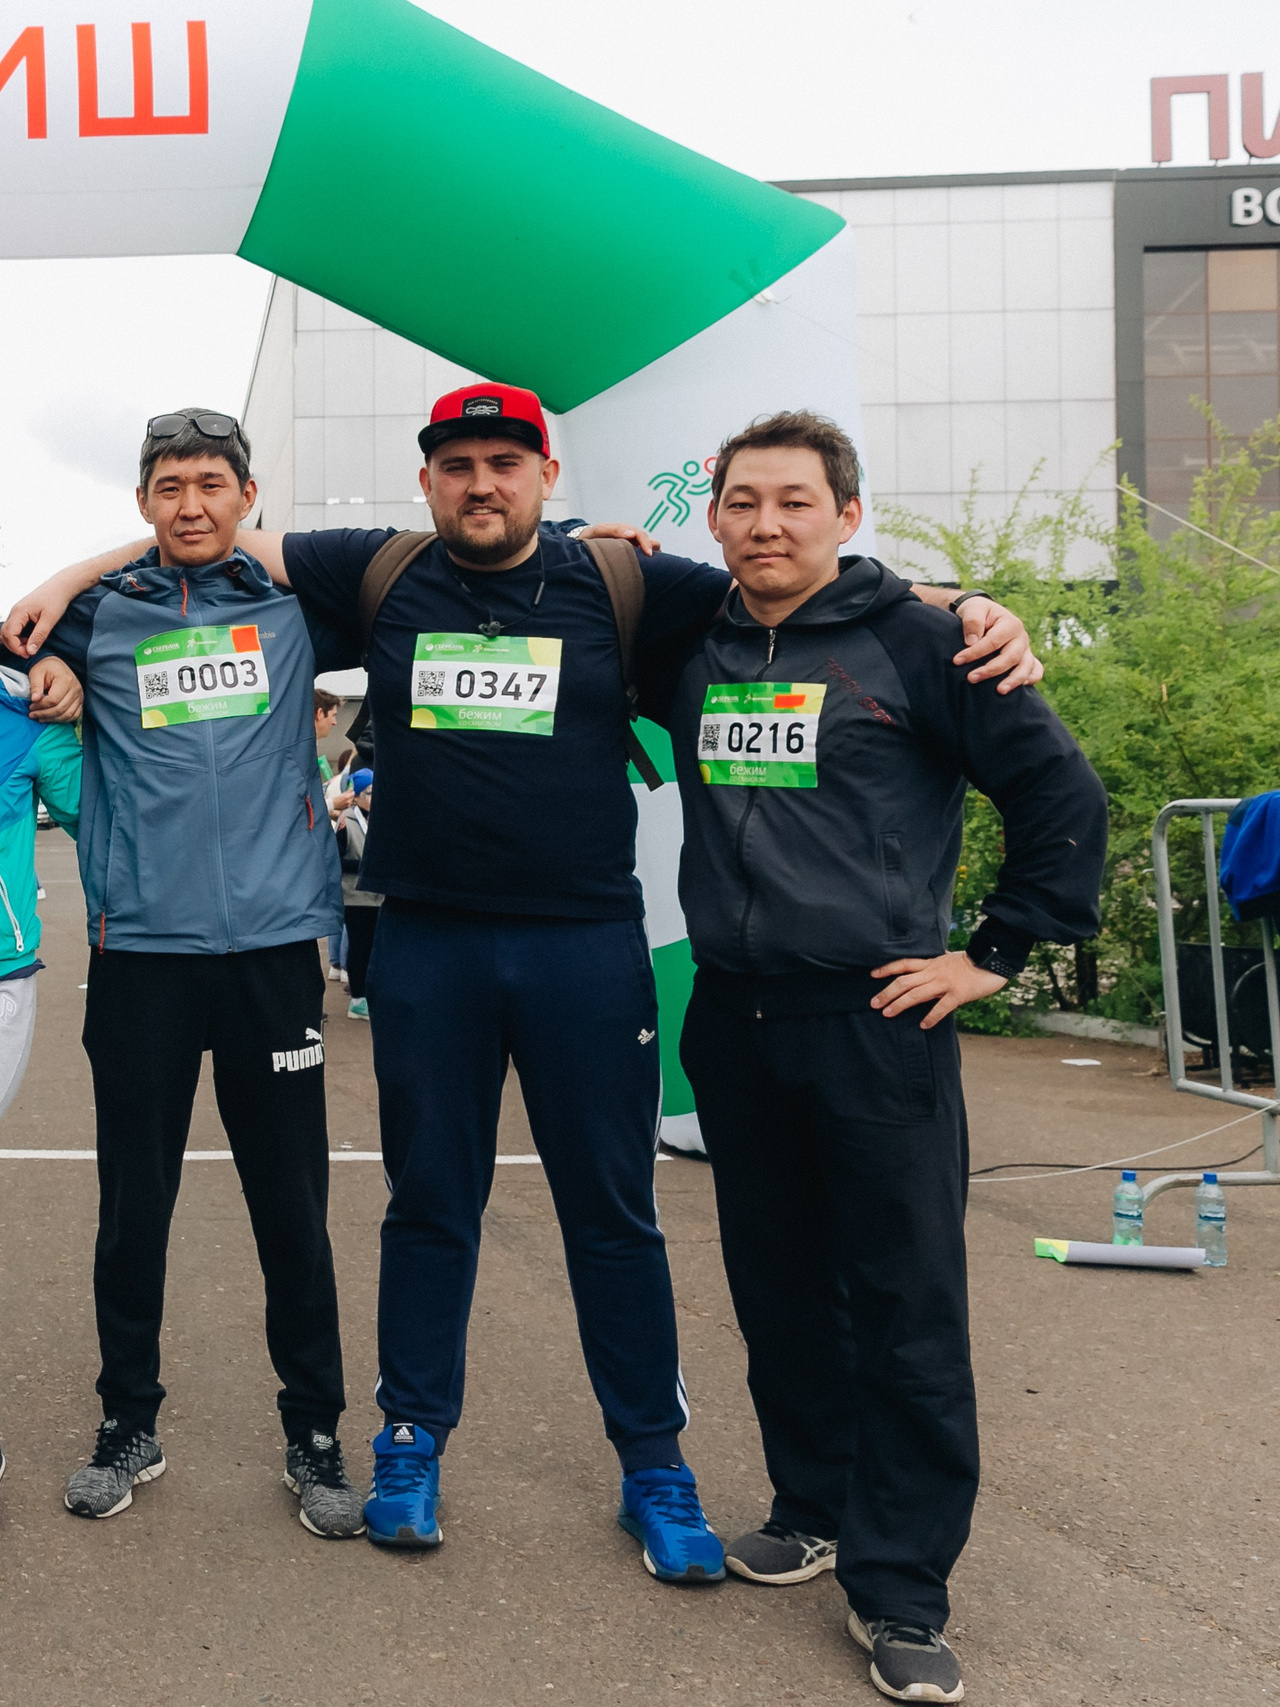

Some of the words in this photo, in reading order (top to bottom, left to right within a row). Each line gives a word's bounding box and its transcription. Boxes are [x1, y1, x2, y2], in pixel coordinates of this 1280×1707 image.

[178, 659, 259, 694] 0003
[455, 669, 548, 703] 0347
[187, 701, 228, 714] бежим
[458, 708, 503, 721] бежим
[727, 721, 806, 754] 0216
[729, 763, 767, 776] бежим
[272, 1043, 323, 1073] PUMA
[313, 1434, 333, 1445] FILA
